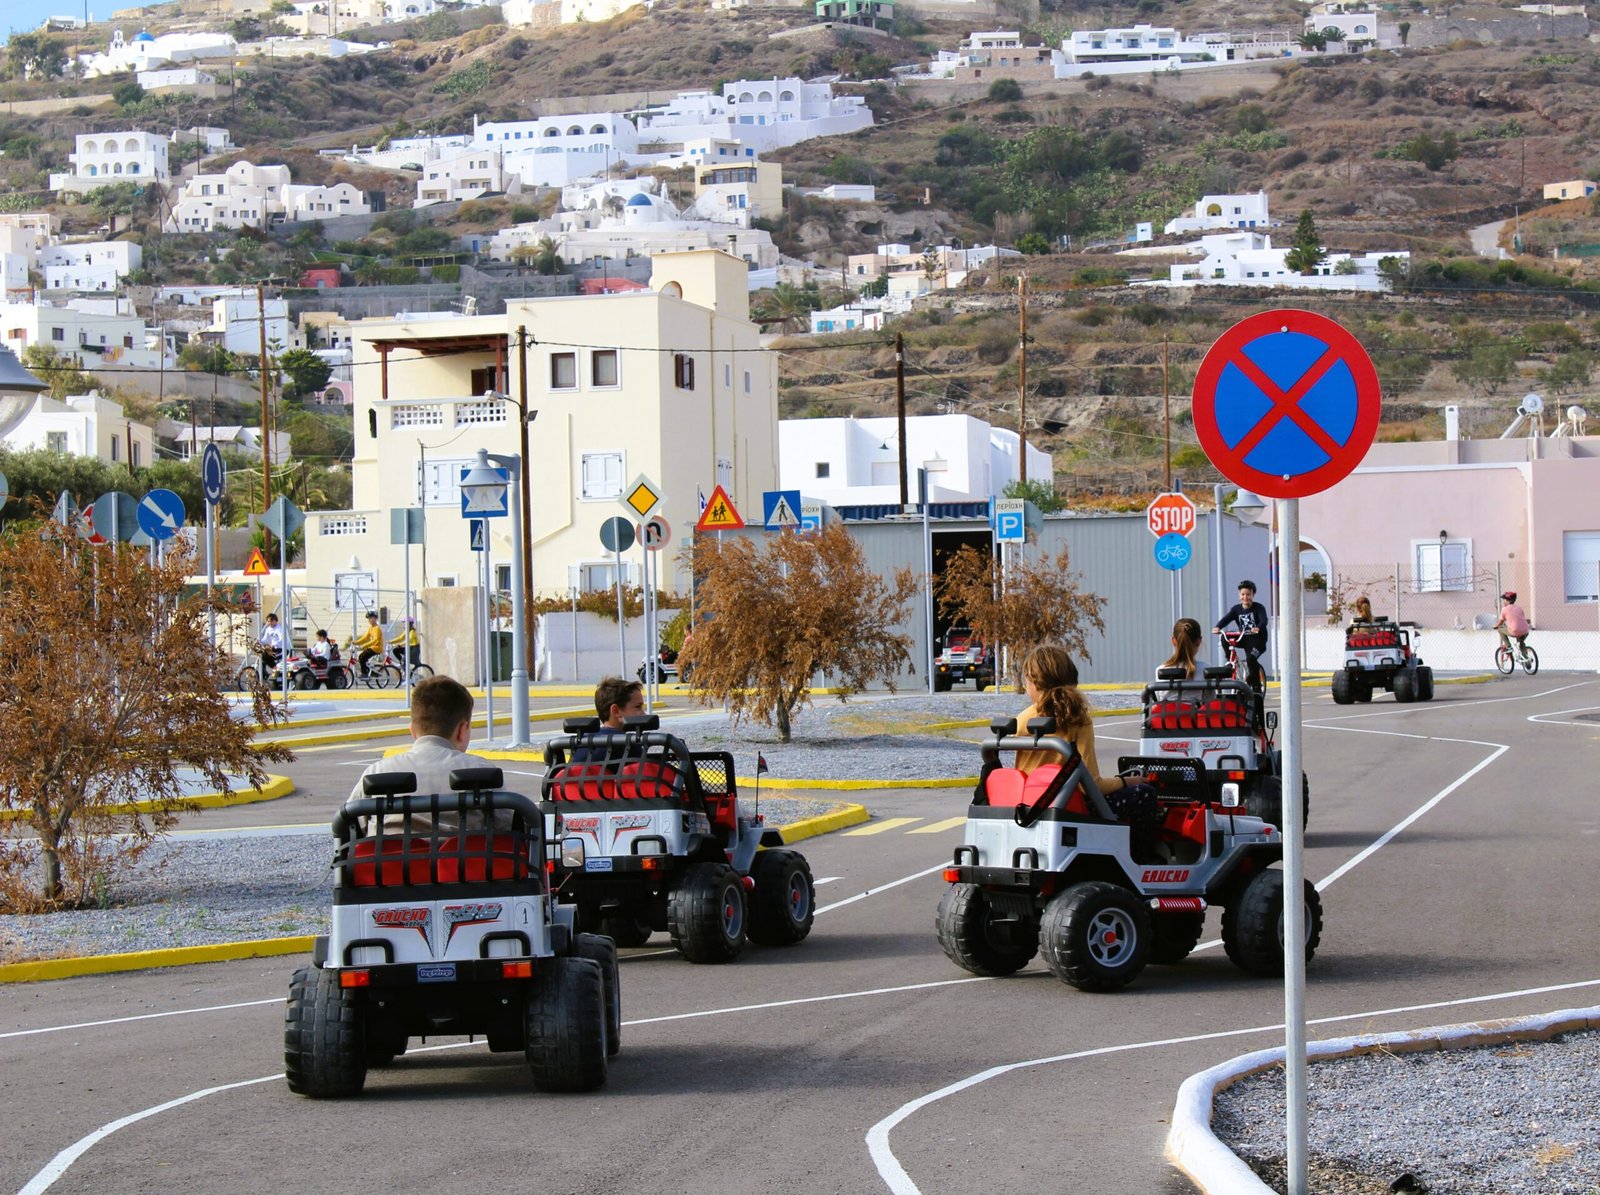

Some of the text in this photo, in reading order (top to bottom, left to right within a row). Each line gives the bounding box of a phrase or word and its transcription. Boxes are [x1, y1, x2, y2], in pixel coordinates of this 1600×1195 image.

[802, 505, 819, 513] ΡΙΟΧΗ
[1002, 516, 1019, 535] P
[1151, 506, 1192, 531] STOP
[663, 819, 672, 834] 2
[1141, 869, 1190, 883] GAUCHO
[375, 909, 430, 924] GAUCHO
[522, 907, 529, 925] 1
